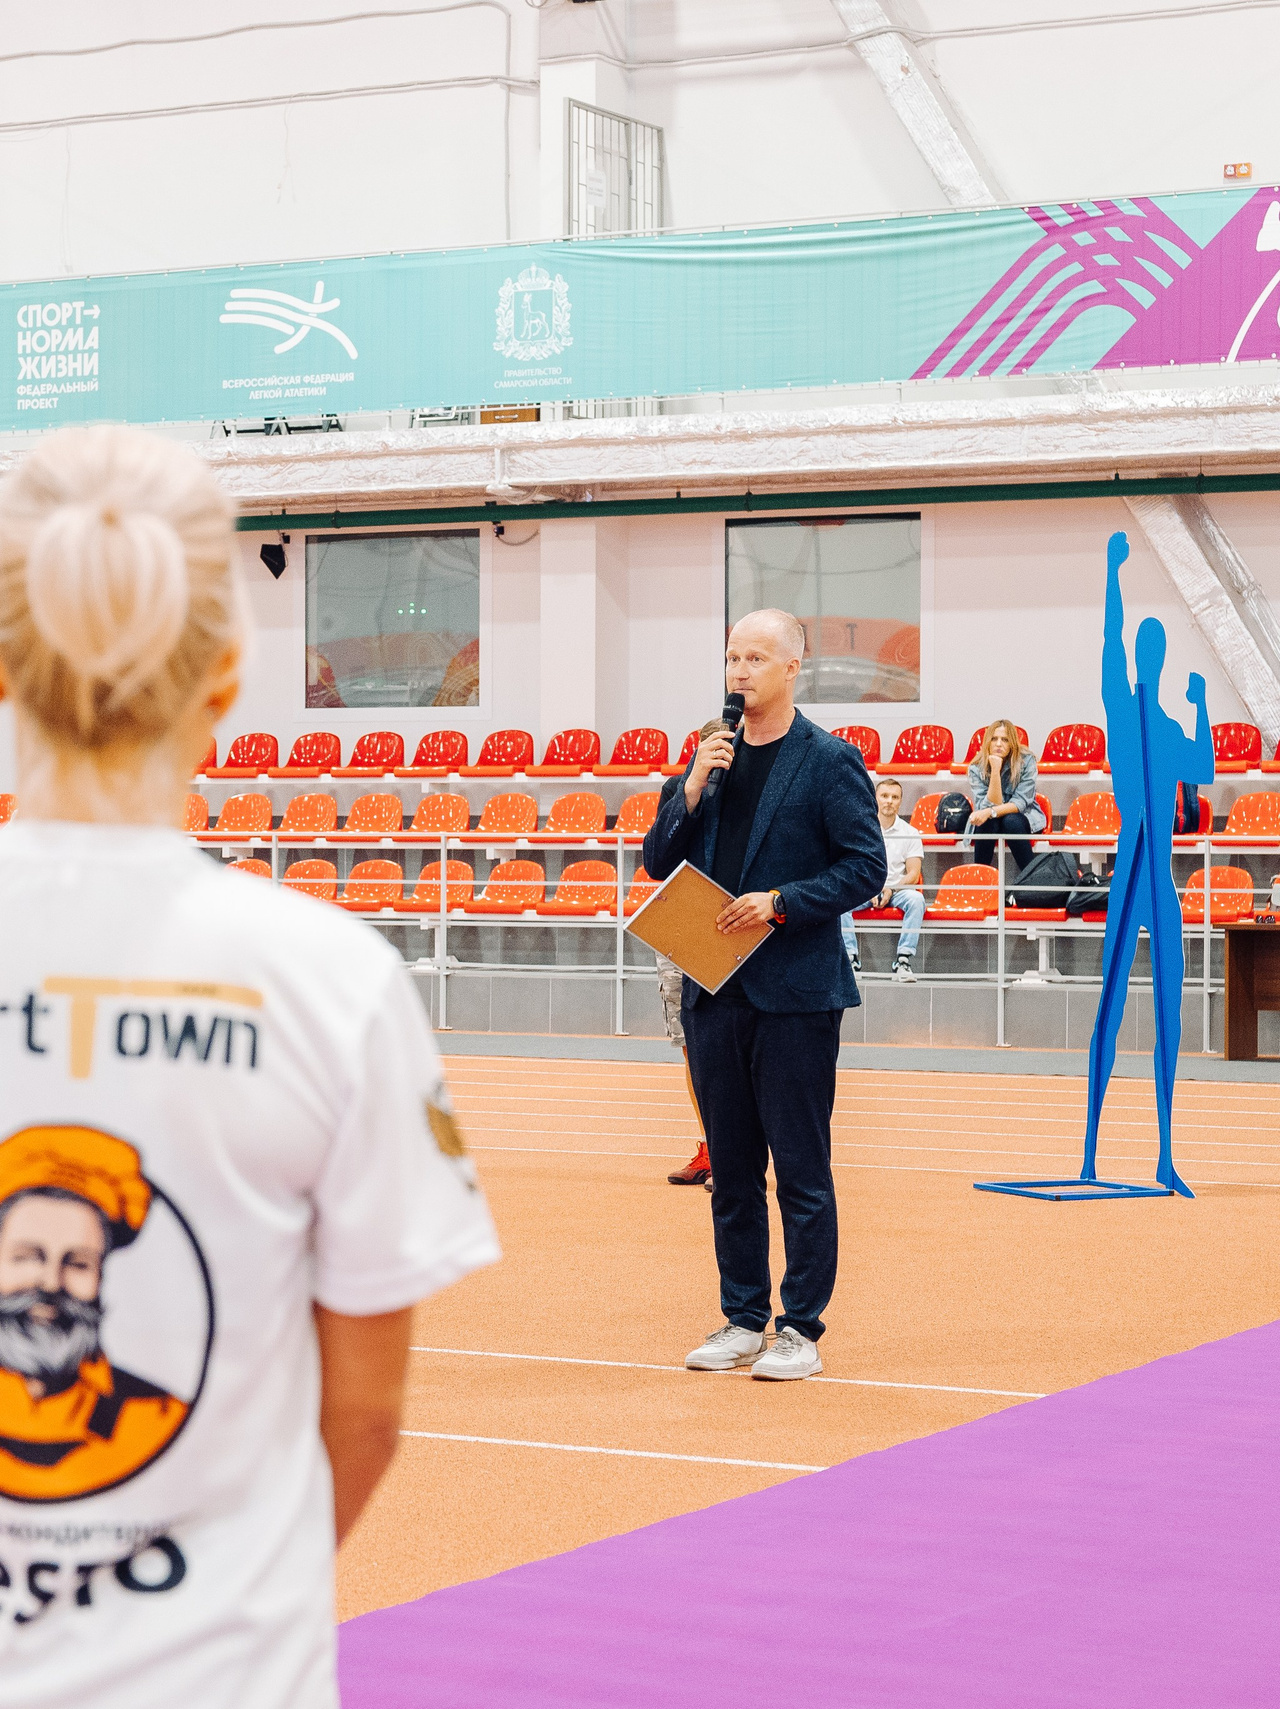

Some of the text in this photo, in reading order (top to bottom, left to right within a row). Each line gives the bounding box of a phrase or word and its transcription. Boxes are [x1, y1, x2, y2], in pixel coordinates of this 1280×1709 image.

[17, 301, 85, 328] СПОРТ
[17, 326, 99, 354] НОРМА
[17, 352, 99, 380] ЖИЗНИ
[504, 367, 562, 377] ПРАВИТЕЛЬСТВО
[17, 378, 99, 397] ФЕДЕРАЛЬНЫЙ
[222, 372, 355, 389] ВСЕРОССИЙСКАЯ ФЕДЕРАЦИЯ
[494, 376, 572, 389] САМАРСКОЙ ОБЛАСТИ
[249, 386, 326, 400] ЛЕГКОЙ АТЛЕТИКИ
[17, 397, 59, 410] ПРОЕКТ
